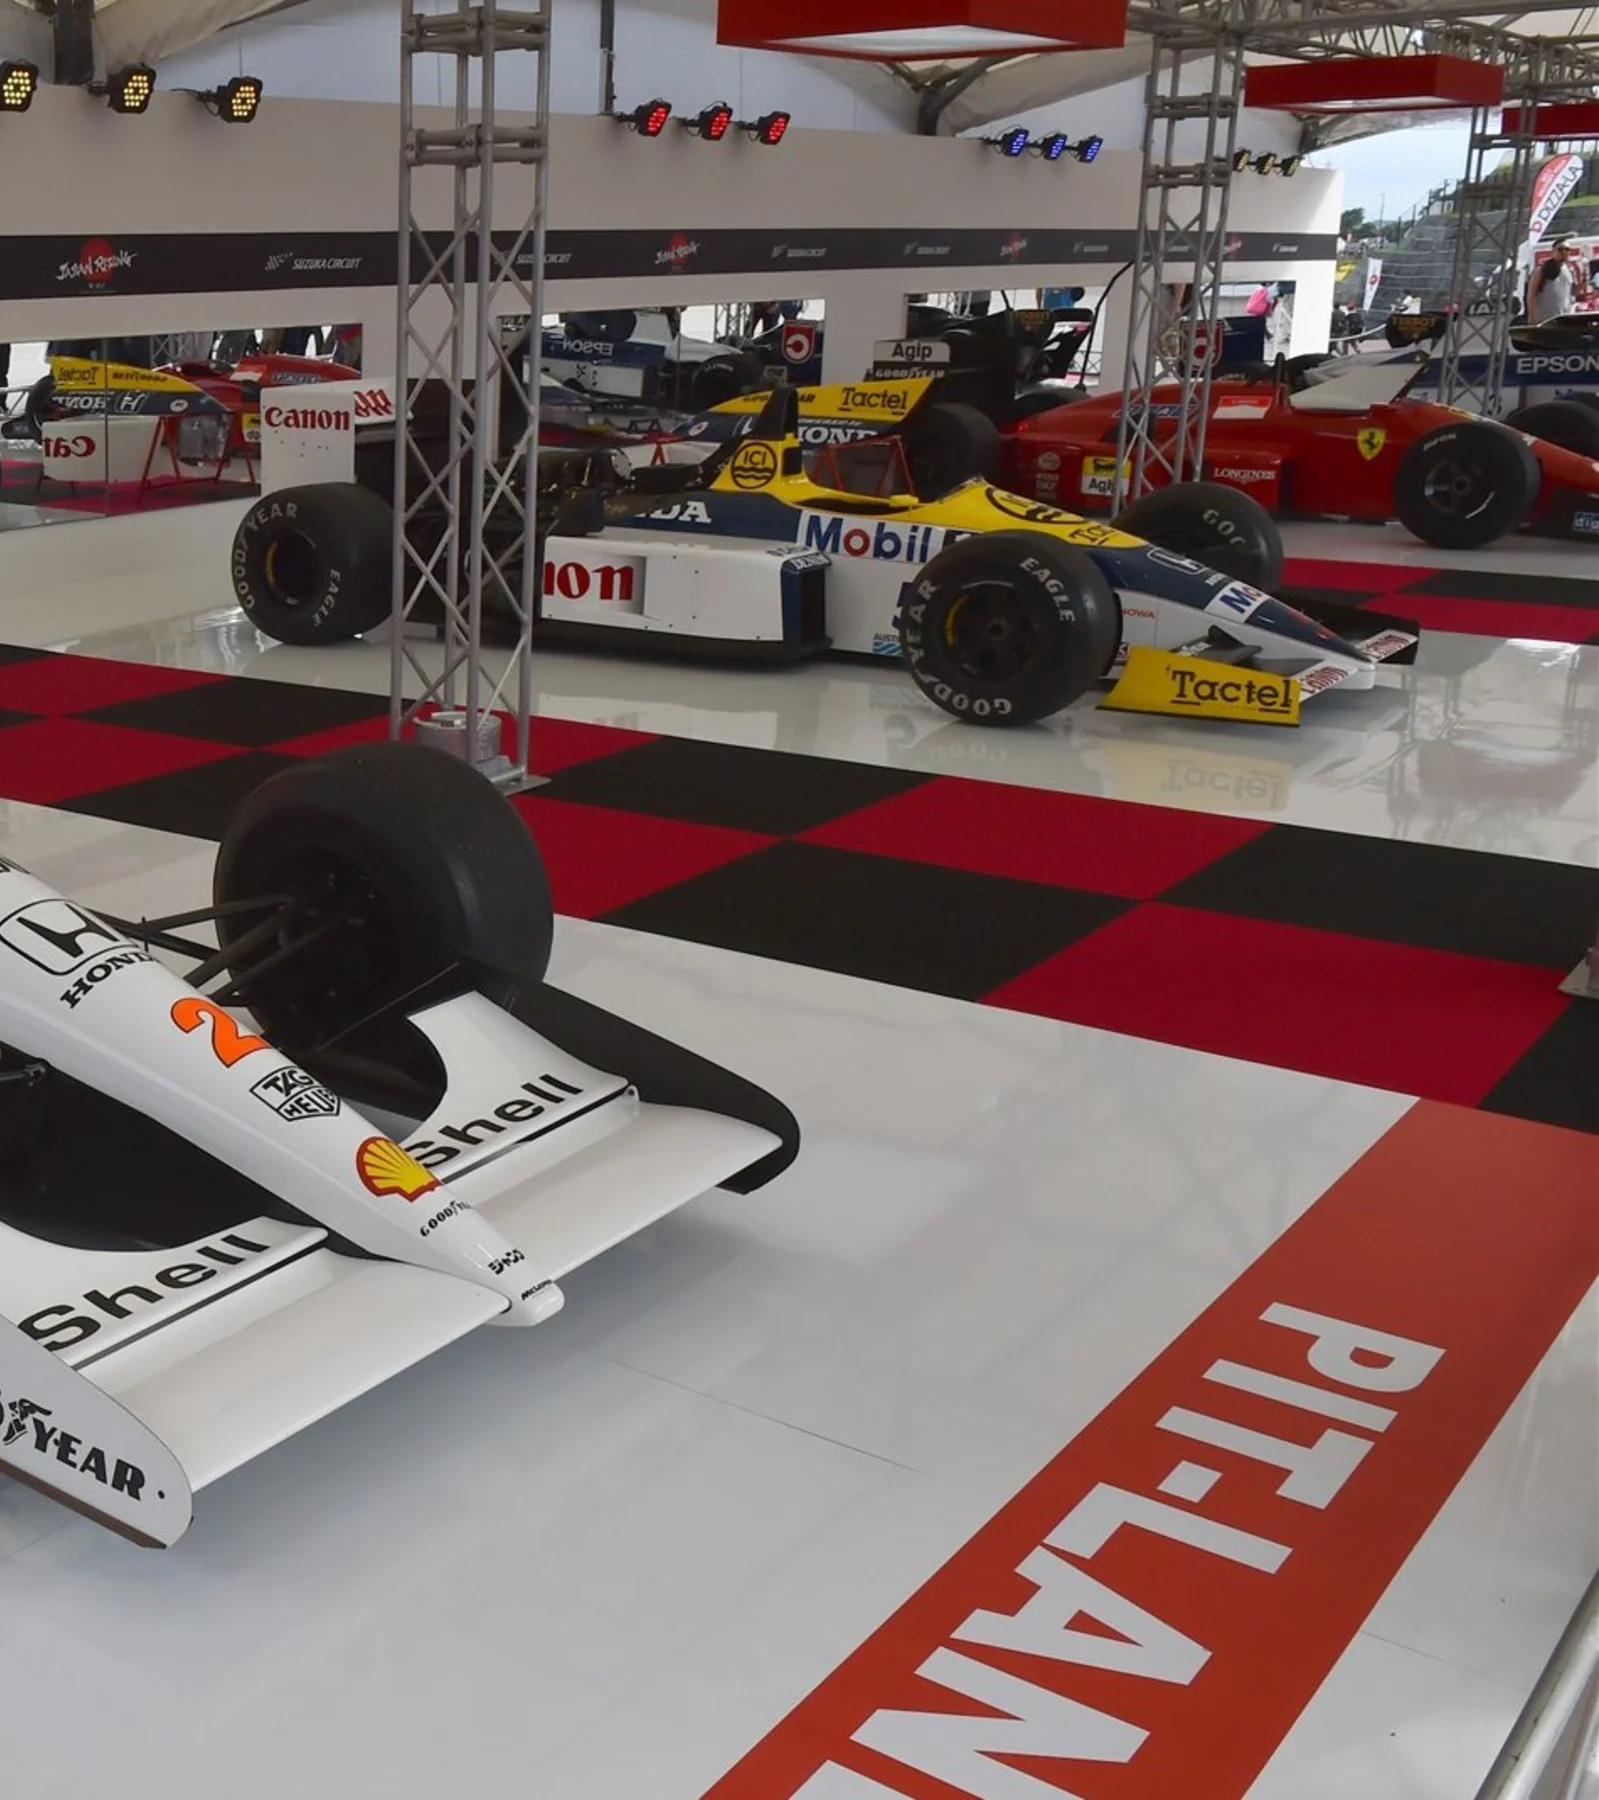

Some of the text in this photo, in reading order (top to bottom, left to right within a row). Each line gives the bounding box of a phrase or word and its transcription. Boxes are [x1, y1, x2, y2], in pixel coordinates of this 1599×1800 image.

[892, 343, 933, 361] Agip
[1516, 356, 1599, 376] EPSON
[875, 367, 945, 379] GOODYEAR
[840, 386, 909, 411] Tactel
[264, 405, 350, 431] Canon
[743, 450, 767, 466] ICI
[1088, 478, 1116, 493] Agi
[1213, 467, 1277, 481] LONGINES
[805, 514, 933, 563] Mobil
[312, 568, 341, 628] EAGLE
[1019, 556, 1076, 624] EAGLE
[905, 577, 1013, 717] GOODYEAR
[1170, 669, 1293, 709] Tactel
[169, 997, 269, 1069] 2
[261, 1069, 315, 1098] TAG
[404, 1073, 584, 1168] Shell
[17, 1233, 272, 1353] Shell
